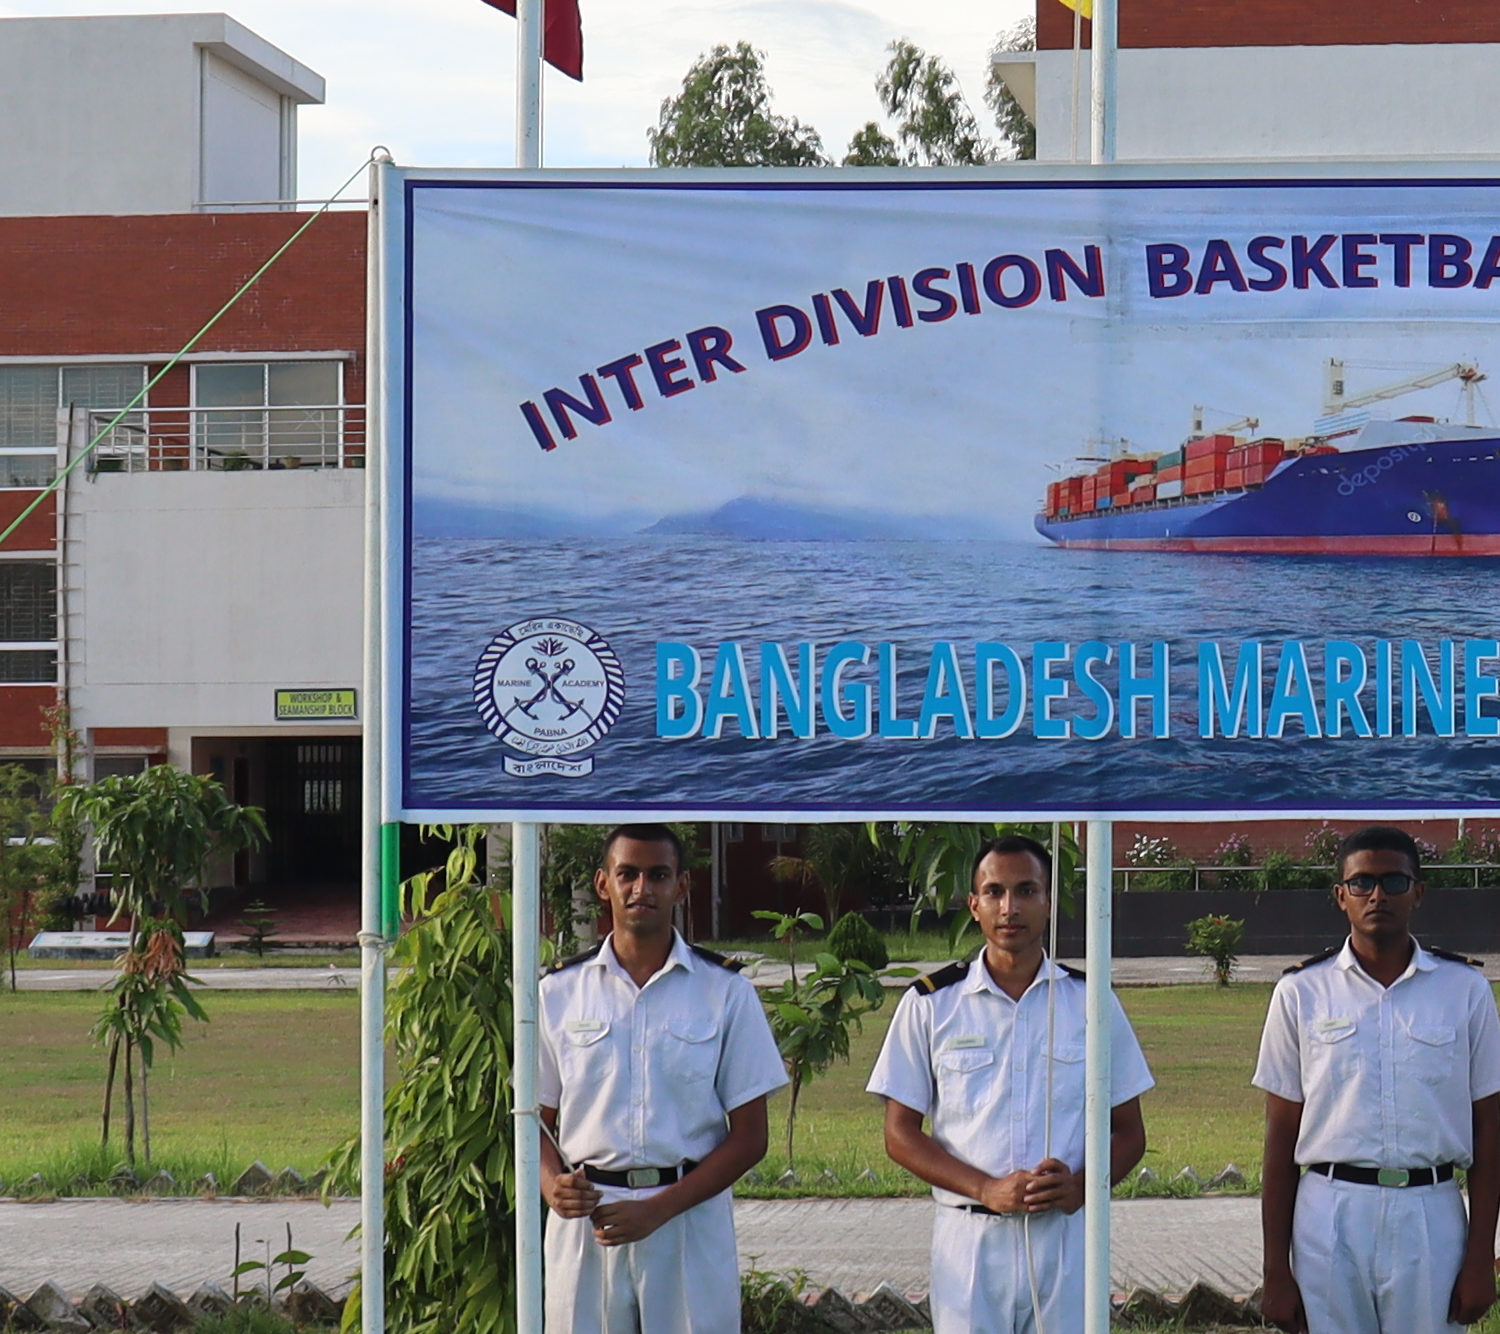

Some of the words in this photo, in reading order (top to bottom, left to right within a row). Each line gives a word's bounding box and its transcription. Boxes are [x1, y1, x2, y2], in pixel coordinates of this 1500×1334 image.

[519, 325, 747, 453] INTER
[755, 244, 1106, 362] DIVISION
[496, 679, 532, 687] MARINE
[561, 679, 605, 688] ACADEMY
[655, 640, 1171, 740] BANGLADESH
[1197, 639, 1500, 739] MARINE
[289, 692, 333, 704] WORKSHOP
[336, 692, 342, 703] &
[278, 704, 327, 715] SEAMANSHIP
[328, 704, 353, 715] BLOCK
[533, 727, 568, 737] PABNA
[512, 760, 583, 774] বাংলাদেশ
